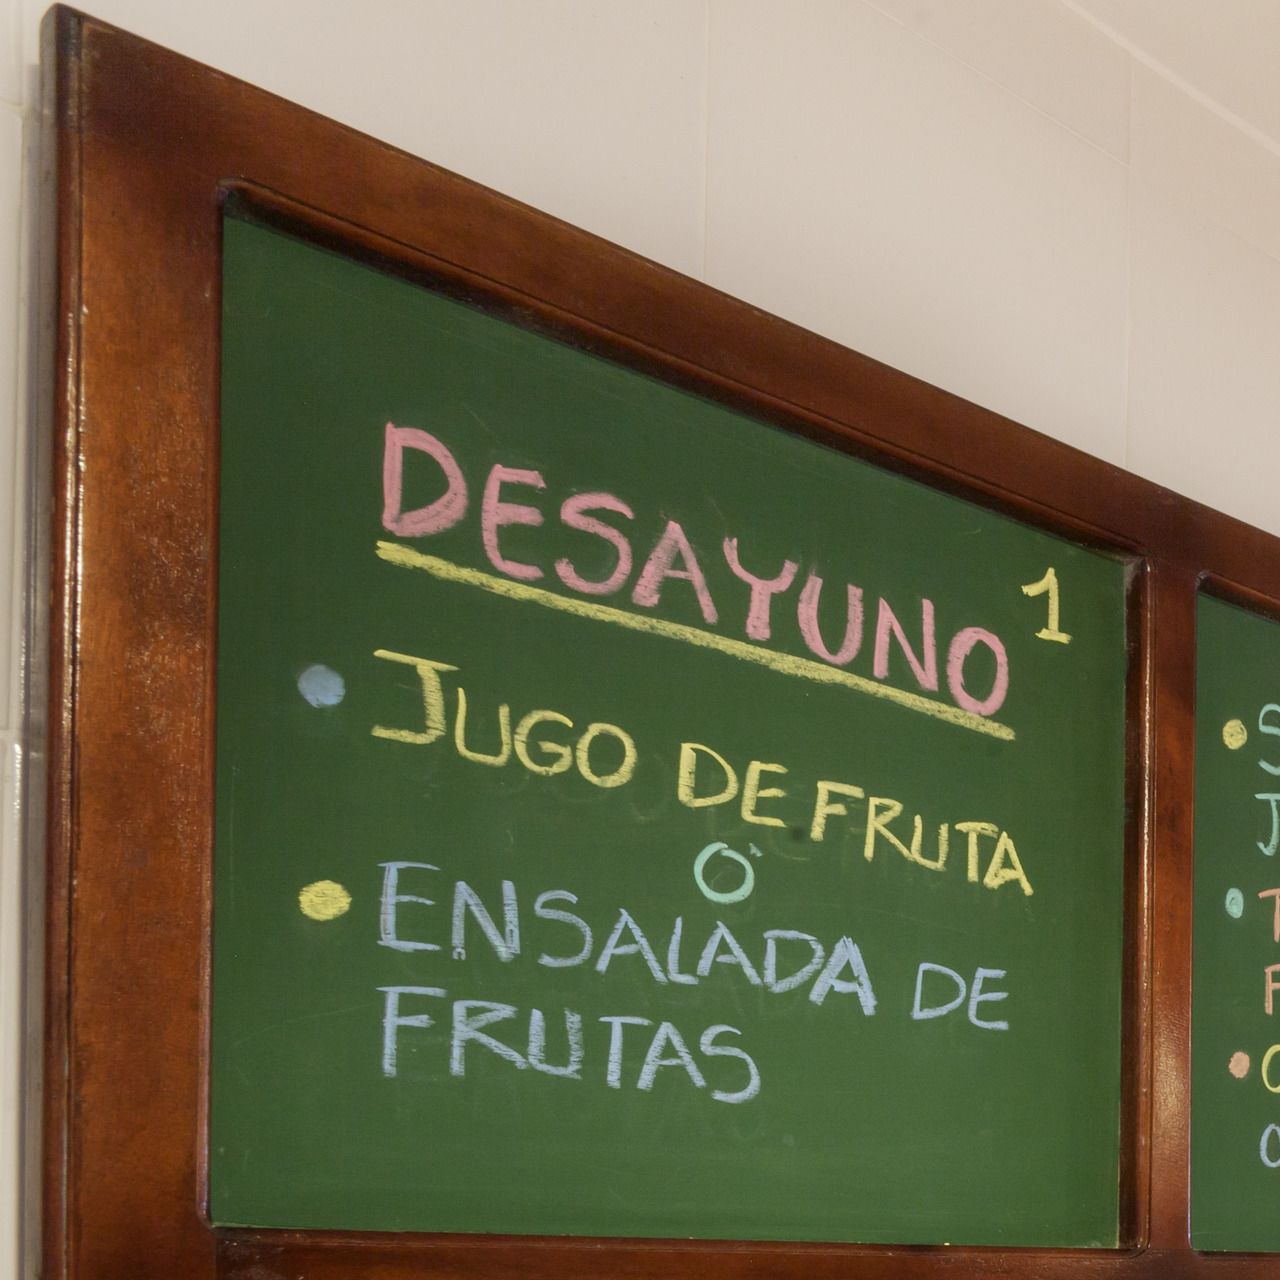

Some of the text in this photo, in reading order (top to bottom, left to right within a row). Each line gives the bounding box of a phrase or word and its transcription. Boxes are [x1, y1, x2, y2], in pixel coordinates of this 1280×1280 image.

[382, 422, 1009, 716] DESAYUNO
[1021, 567, 1072, 643] 1
[371, 649, 1034, 897] JUGO DE FRUTA
[693, 842, 754, 904] O
[378, 861, 1009, 1030] ENSALADA DE
[376, 986, 761, 1104] FRUTAS
